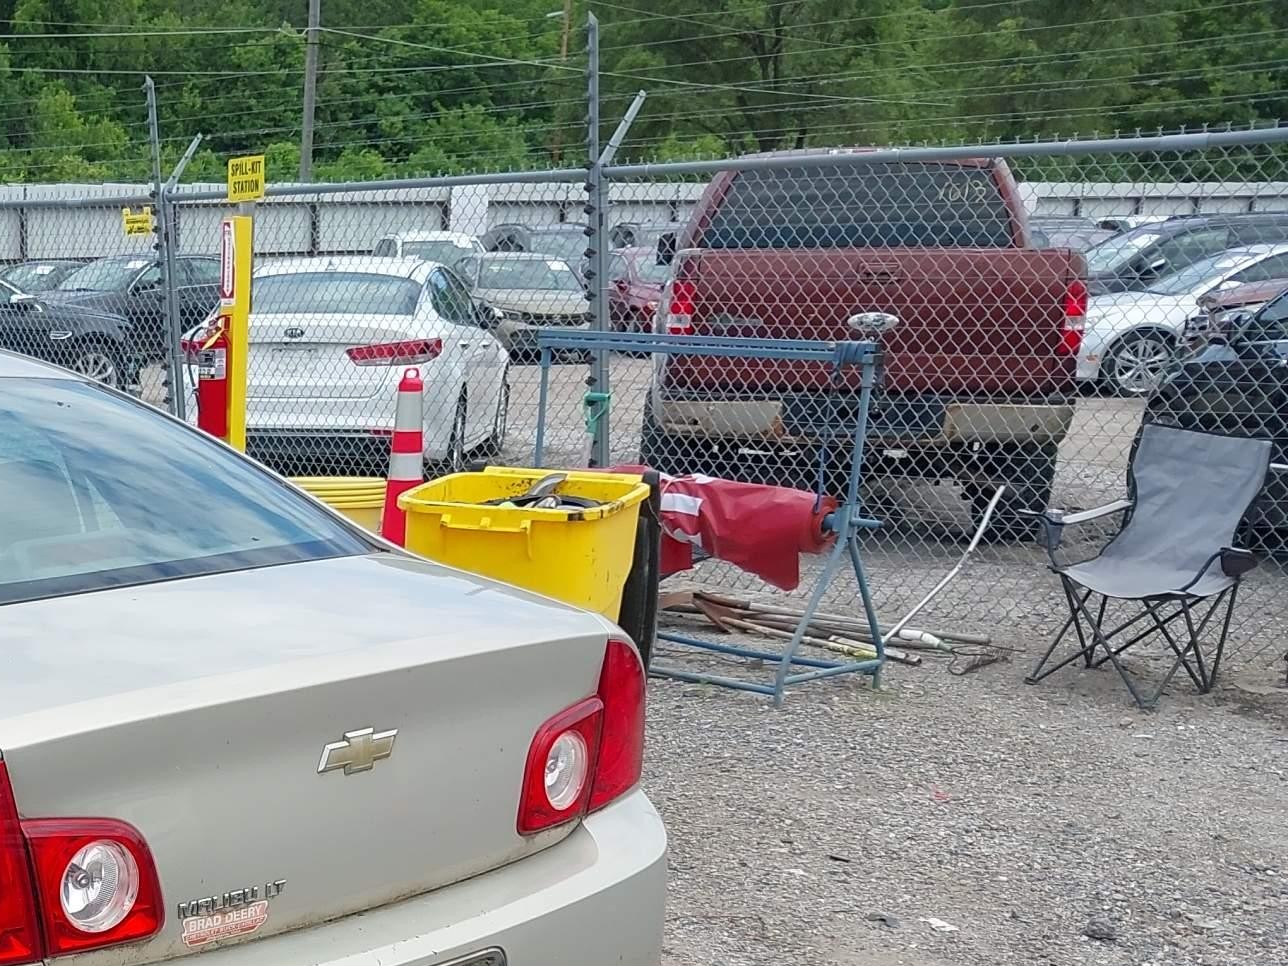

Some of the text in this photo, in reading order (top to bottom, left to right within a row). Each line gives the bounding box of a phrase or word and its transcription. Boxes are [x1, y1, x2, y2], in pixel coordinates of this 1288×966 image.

[231, 161, 261, 176] SPILL-KIT
[233, 180, 259, 194] STATION
[178, 880, 287, 919] MALIBU LT
[190, 906, 262, 932] BRAD DEERY
